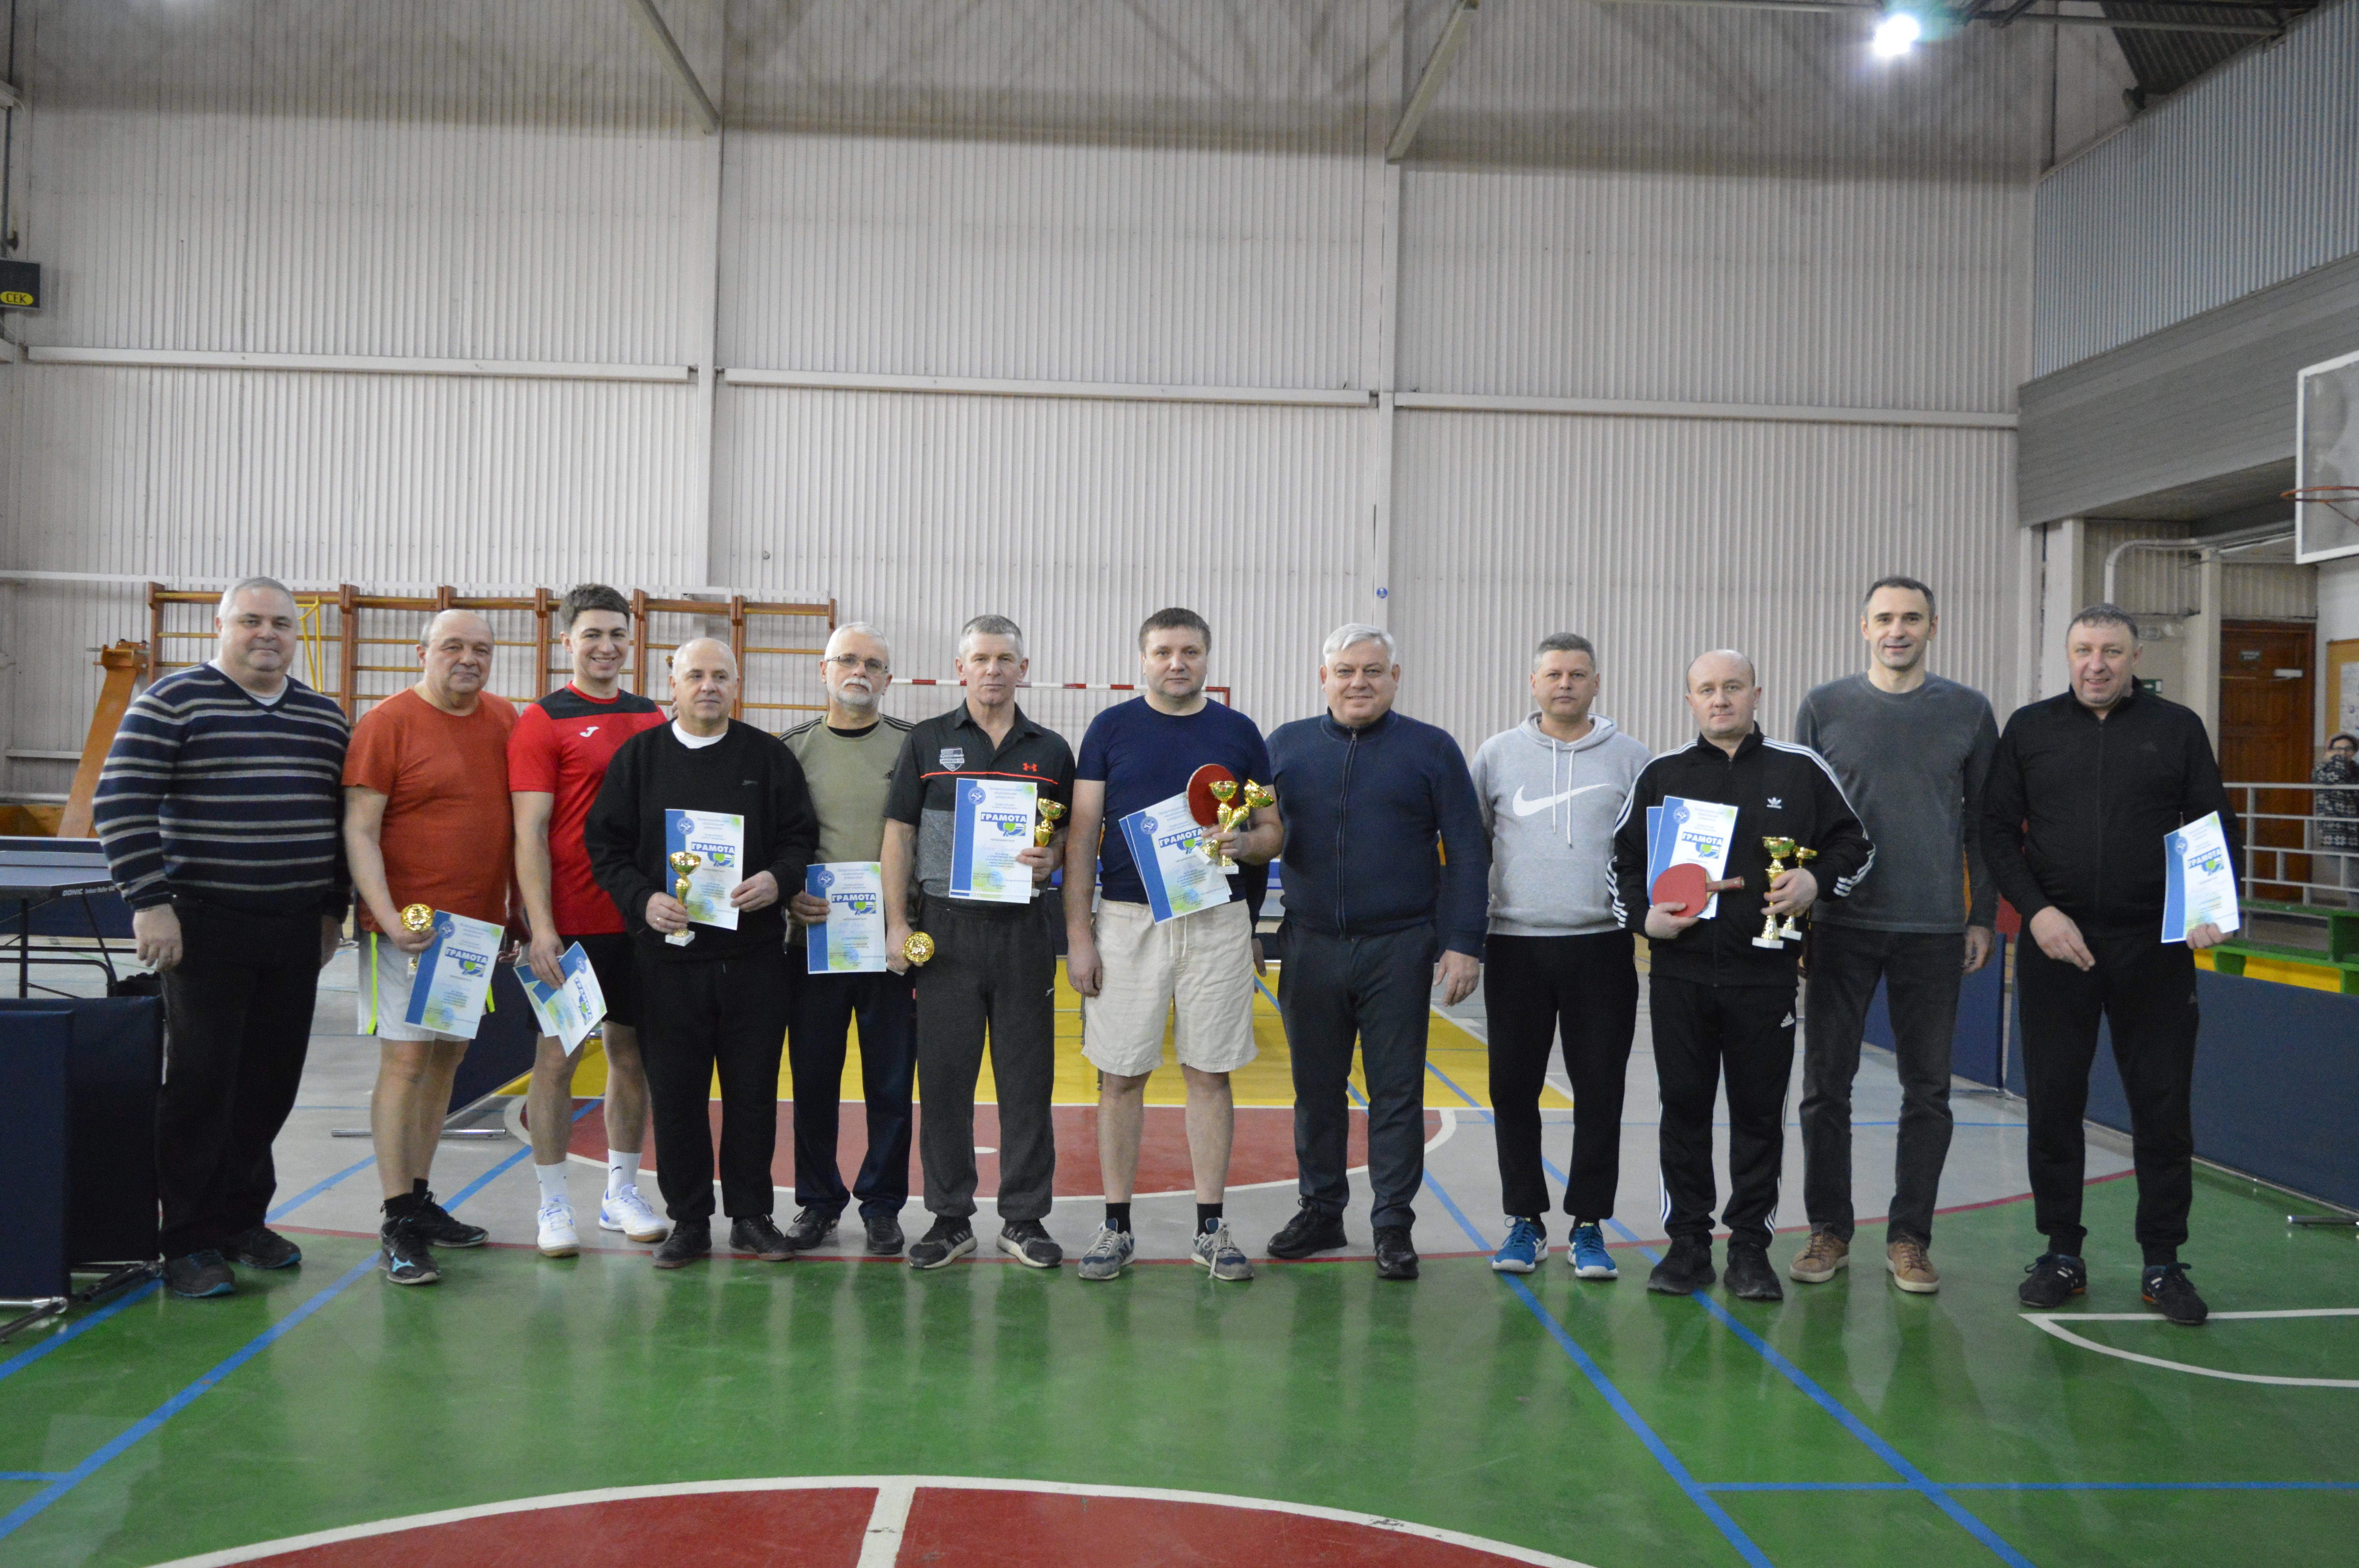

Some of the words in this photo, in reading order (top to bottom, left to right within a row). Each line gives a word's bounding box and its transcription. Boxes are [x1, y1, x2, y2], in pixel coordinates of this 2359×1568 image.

[981, 813, 1027, 822] ГРАМОТА
[1160, 828, 1203, 846] ГРАМОТА
[1682, 833, 1723, 846] ГРАМОТА
[692, 843, 735, 854] ГРАМОТА
[2189, 849, 2221, 867] ГРАМОТА
[446, 948, 487, 964] ГРАМОТА
